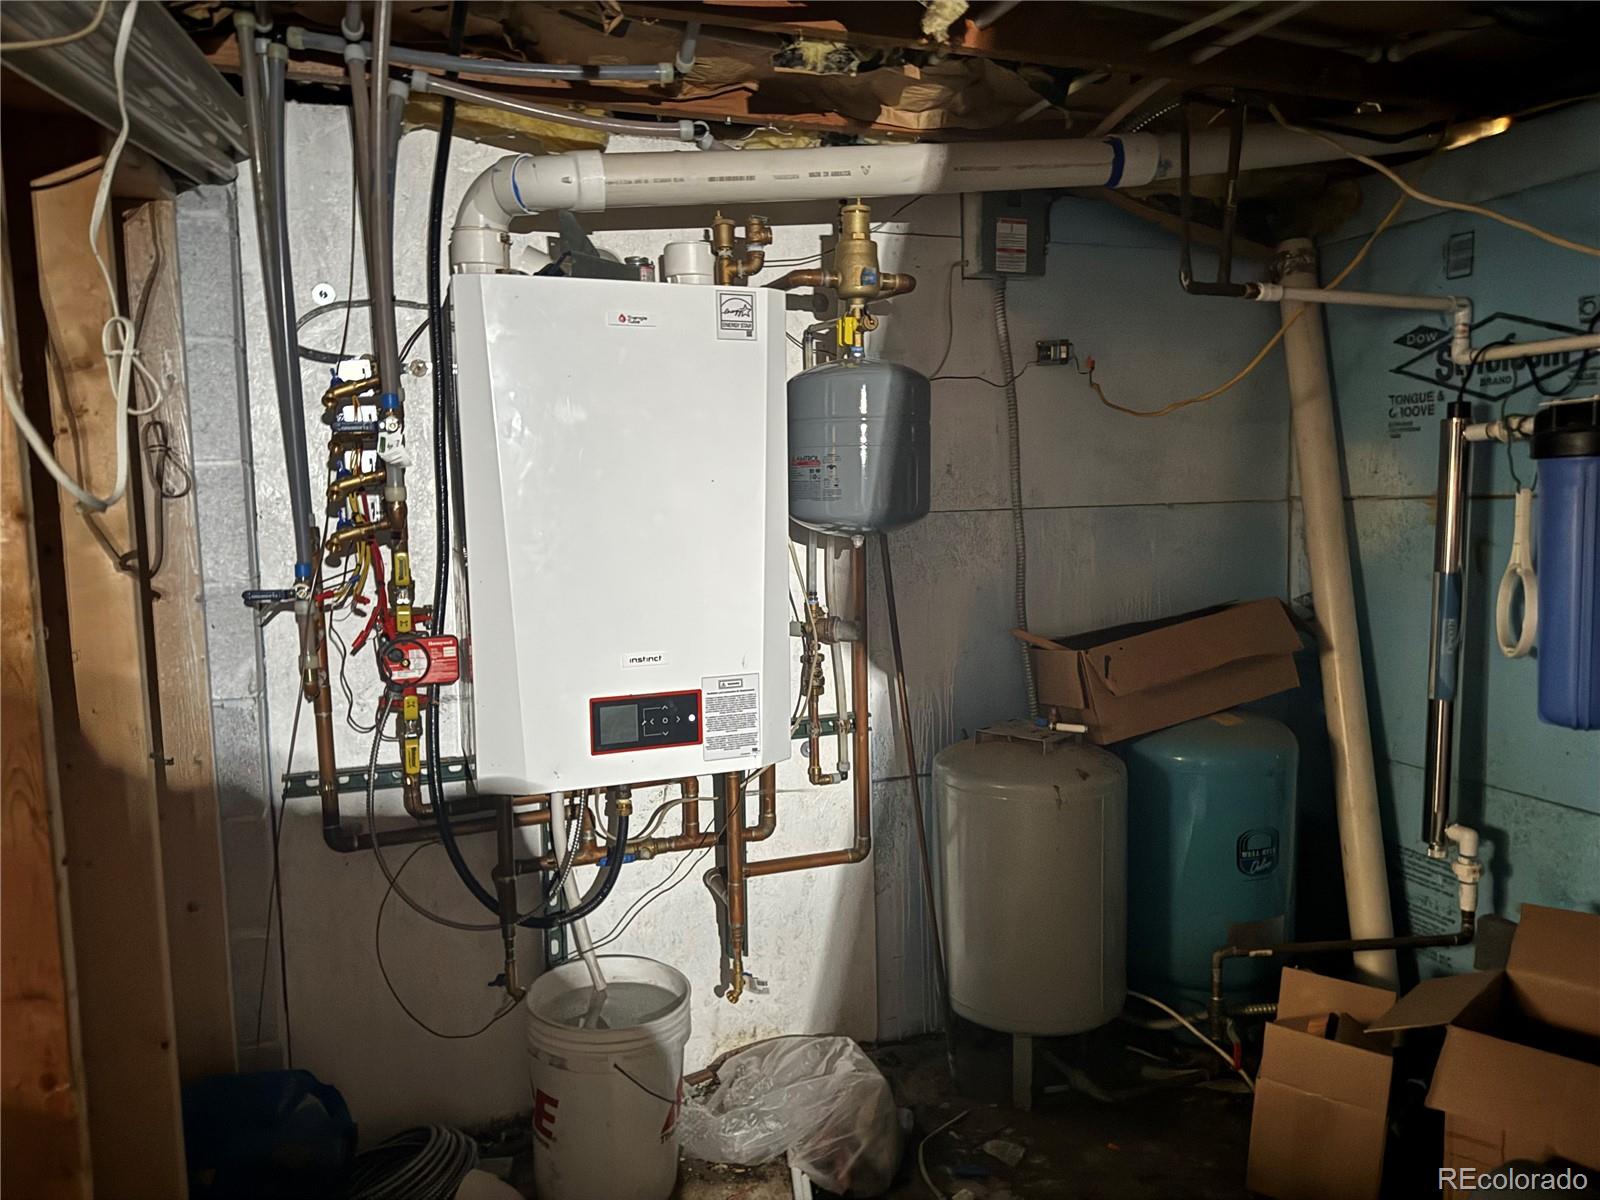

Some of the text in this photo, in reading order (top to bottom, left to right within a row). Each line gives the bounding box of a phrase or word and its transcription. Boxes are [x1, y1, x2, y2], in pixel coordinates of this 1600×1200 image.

[1407, 332, 1438, 346] DOW
[1435, 333, 1570, 383] Srofoam
[1480, 376, 1512, 387] BRAND
[1388, 391, 1435, 405] TONGUE
[629, 655, 662, 663] instinct
